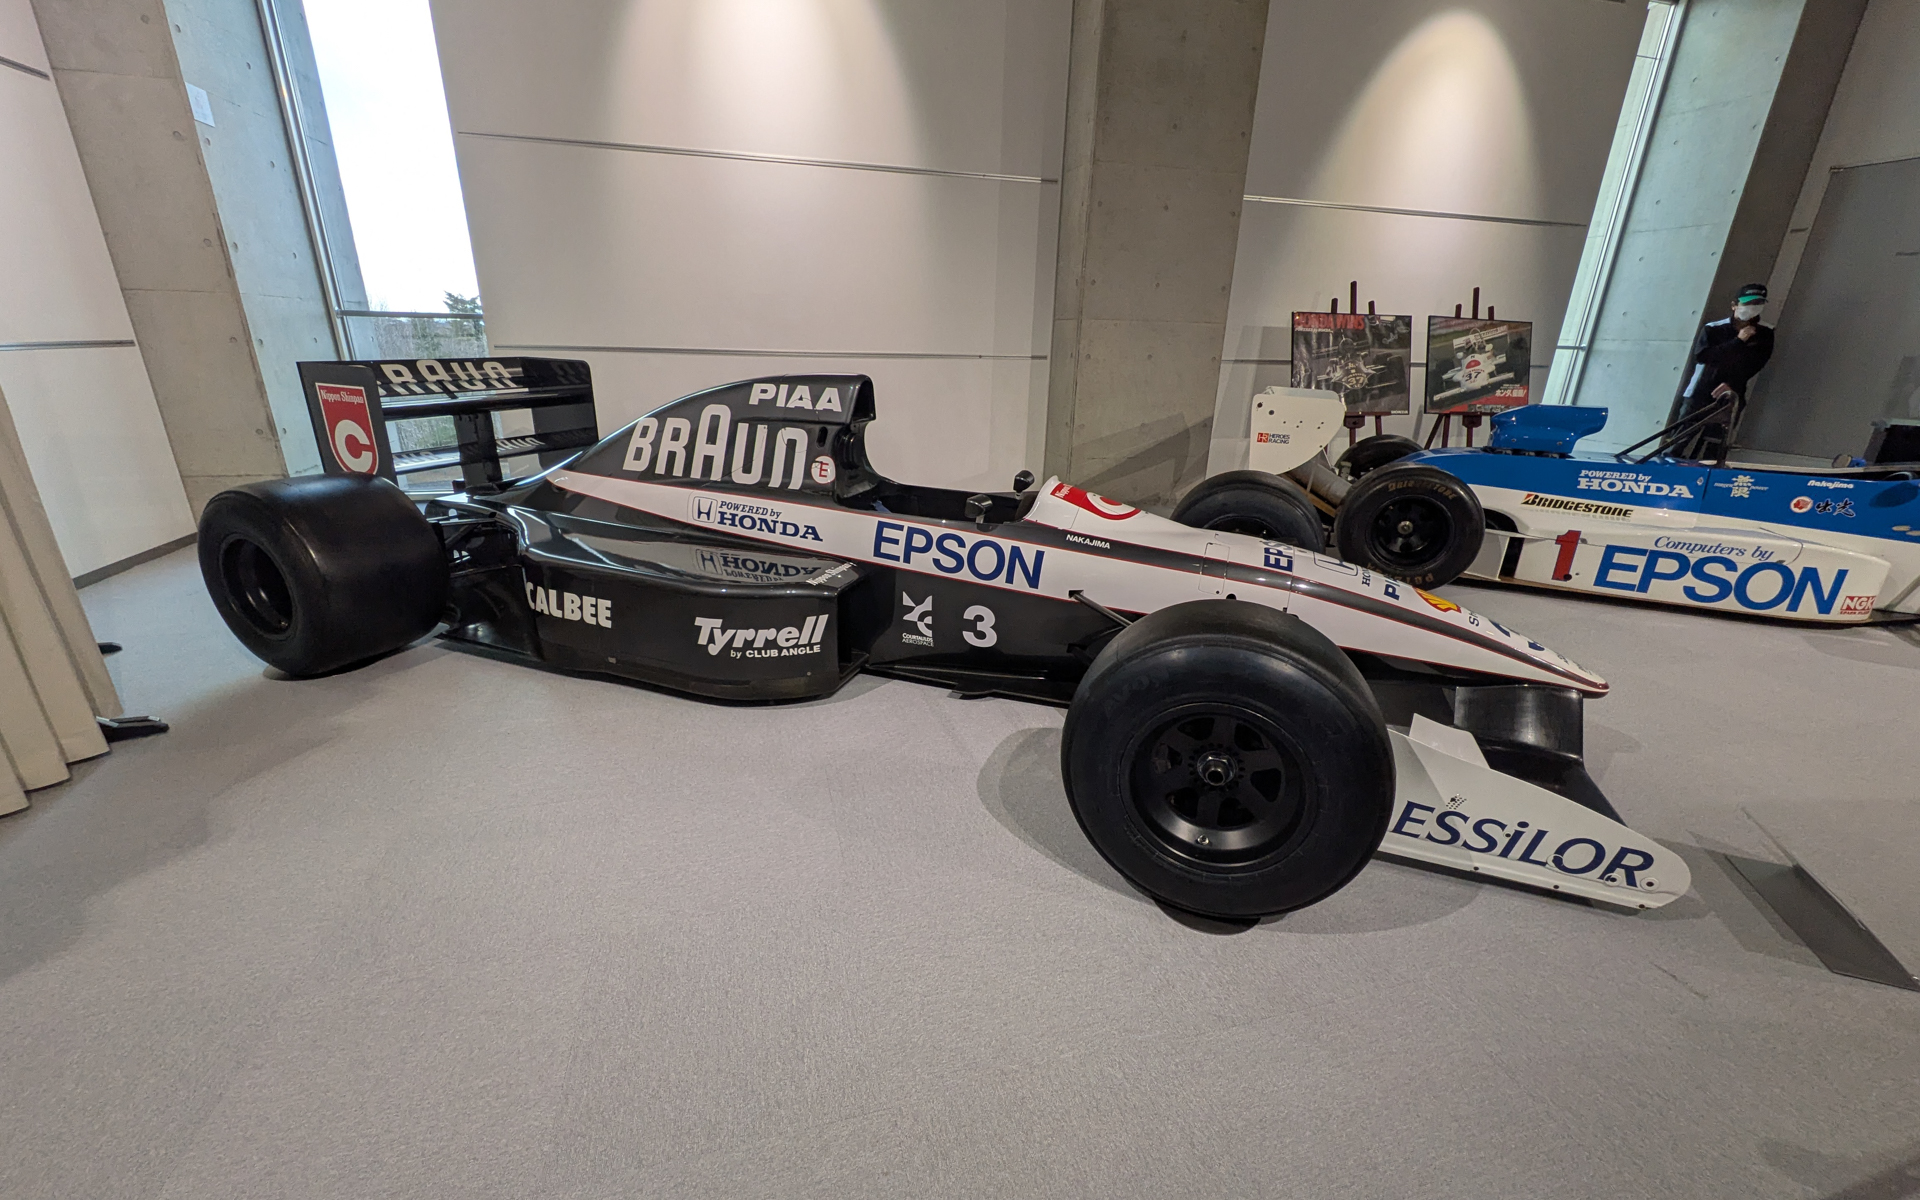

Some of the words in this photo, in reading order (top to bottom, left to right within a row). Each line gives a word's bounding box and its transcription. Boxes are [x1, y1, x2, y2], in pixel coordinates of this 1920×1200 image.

[749, 383, 842, 412] PIAA
[335, 419, 373, 474] C
[622, 404, 808, 490] BRAUN
[819, 461, 829, 478] E
[1579, 469, 1636, 480] POWERED
[1637, 474, 1652, 482] by
[1577, 477, 1694, 499] HONDA
[719, 500, 769, 516] POWERED
[770, 508, 782, 519] by
[1521, 494, 1634, 518] BRIDGESTONE
[717, 511, 823, 542] HONDA
[873, 520, 1045, 589] EPSON
[1066, 534, 1111, 549] NAKAJIMA
[1654, 536, 1747, 557] Computers
[1751, 546, 1775, 561] by
[1552, 530, 1582, 581] 1
[1593, 544, 1849, 615] EPSON
[526, 582, 612, 629] CALBEE
[1843, 596, 1875, 610] NGK
[694, 614, 829, 656] Tyrrell
[962, 604, 998, 648] 3
[730, 649, 742, 659] by
[746, 649, 779, 658] CLUB
[780, 645, 821, 656] ANGLE
[901, 638, 934, 648] AEROSPACE
